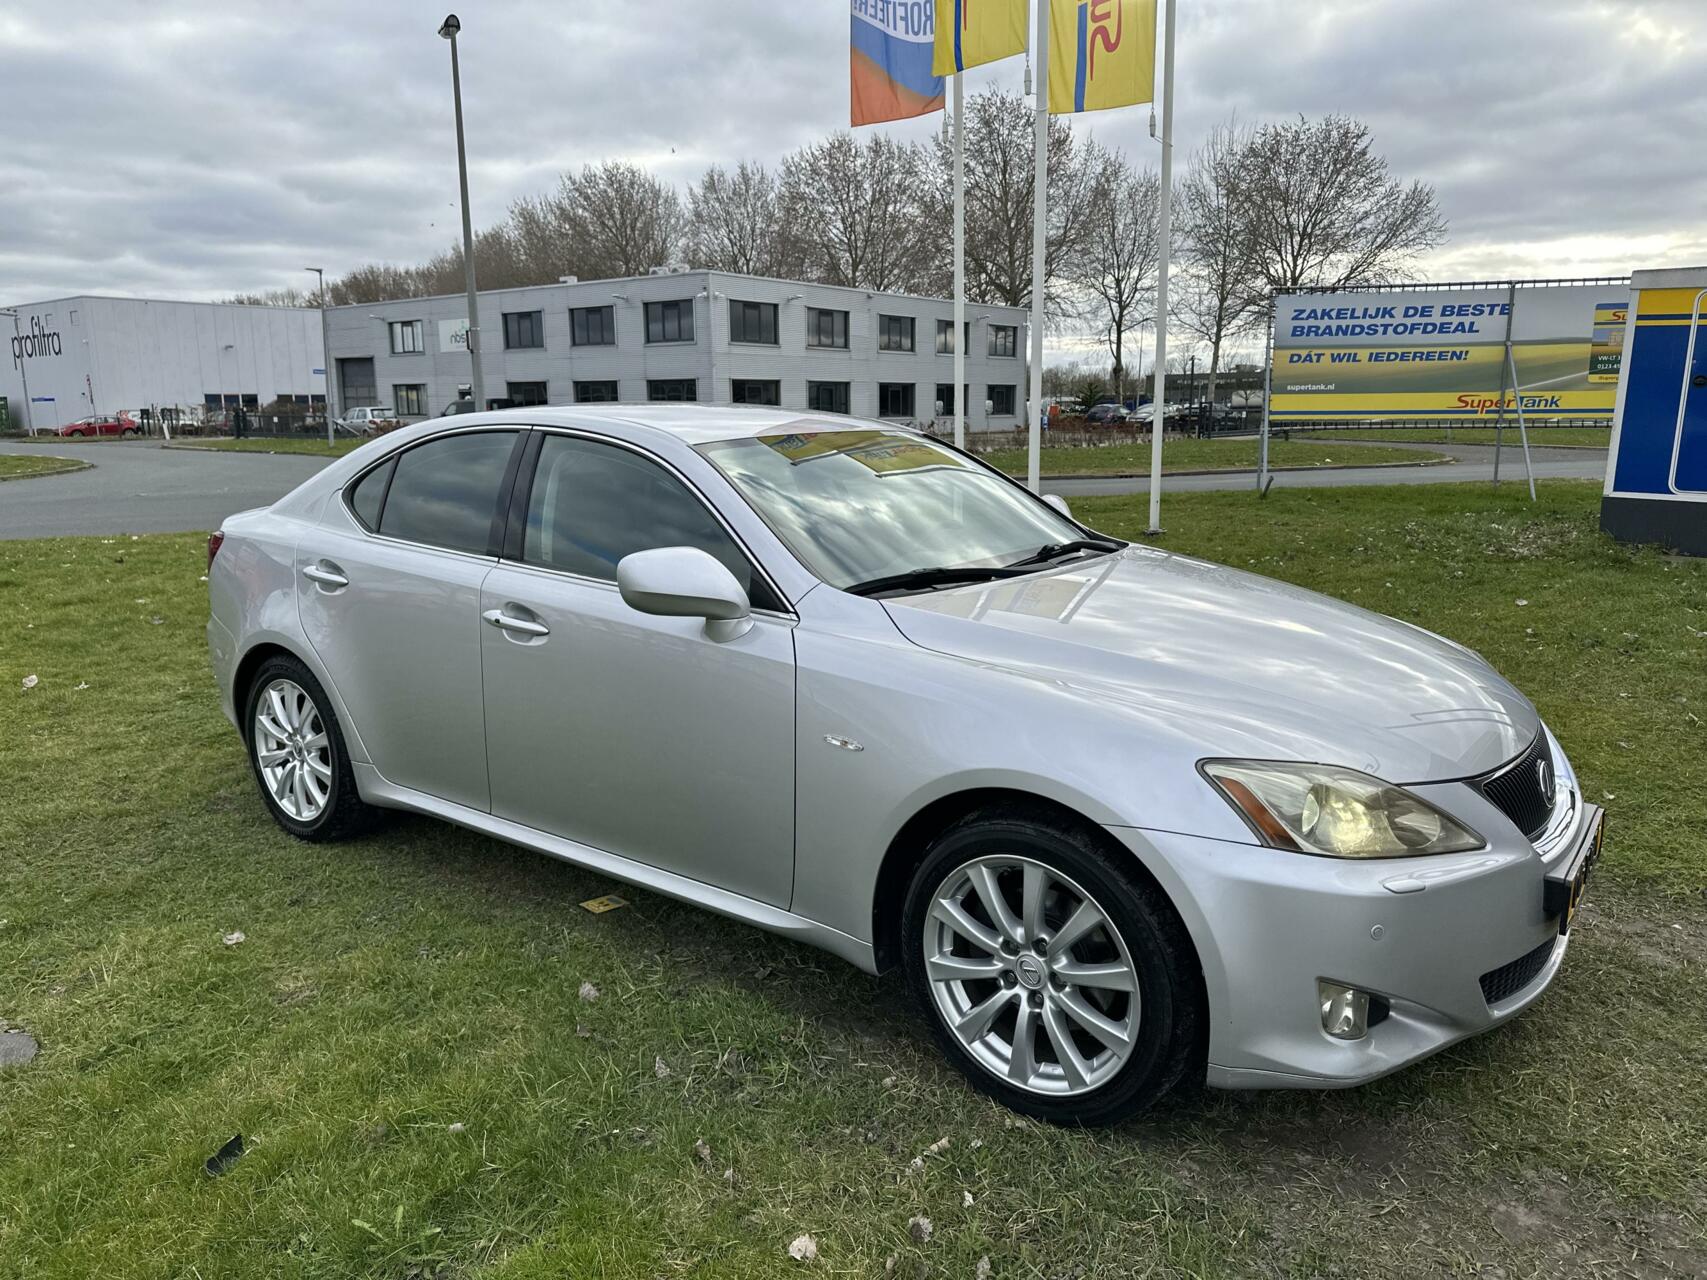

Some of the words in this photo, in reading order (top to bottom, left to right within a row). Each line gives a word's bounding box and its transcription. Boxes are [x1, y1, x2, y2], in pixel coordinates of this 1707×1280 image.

[1291, 306, 1398, 321] ZAKELIJK
[1403, 305, 1435, 319] DE
[1440, 303, 1513, 317] BESTE
[1290, 321, 1480, 337] BRANDSTOFDEAL
[11, 315, 62, 371] profiltra
[1289, 350, 1326, 364] DÁT
[1330, 351, 1362, 363] WIL
[1367, 350, 1469, 363] IEDEREEN!
[1286, 383, 1335, 391] supertank.nl
